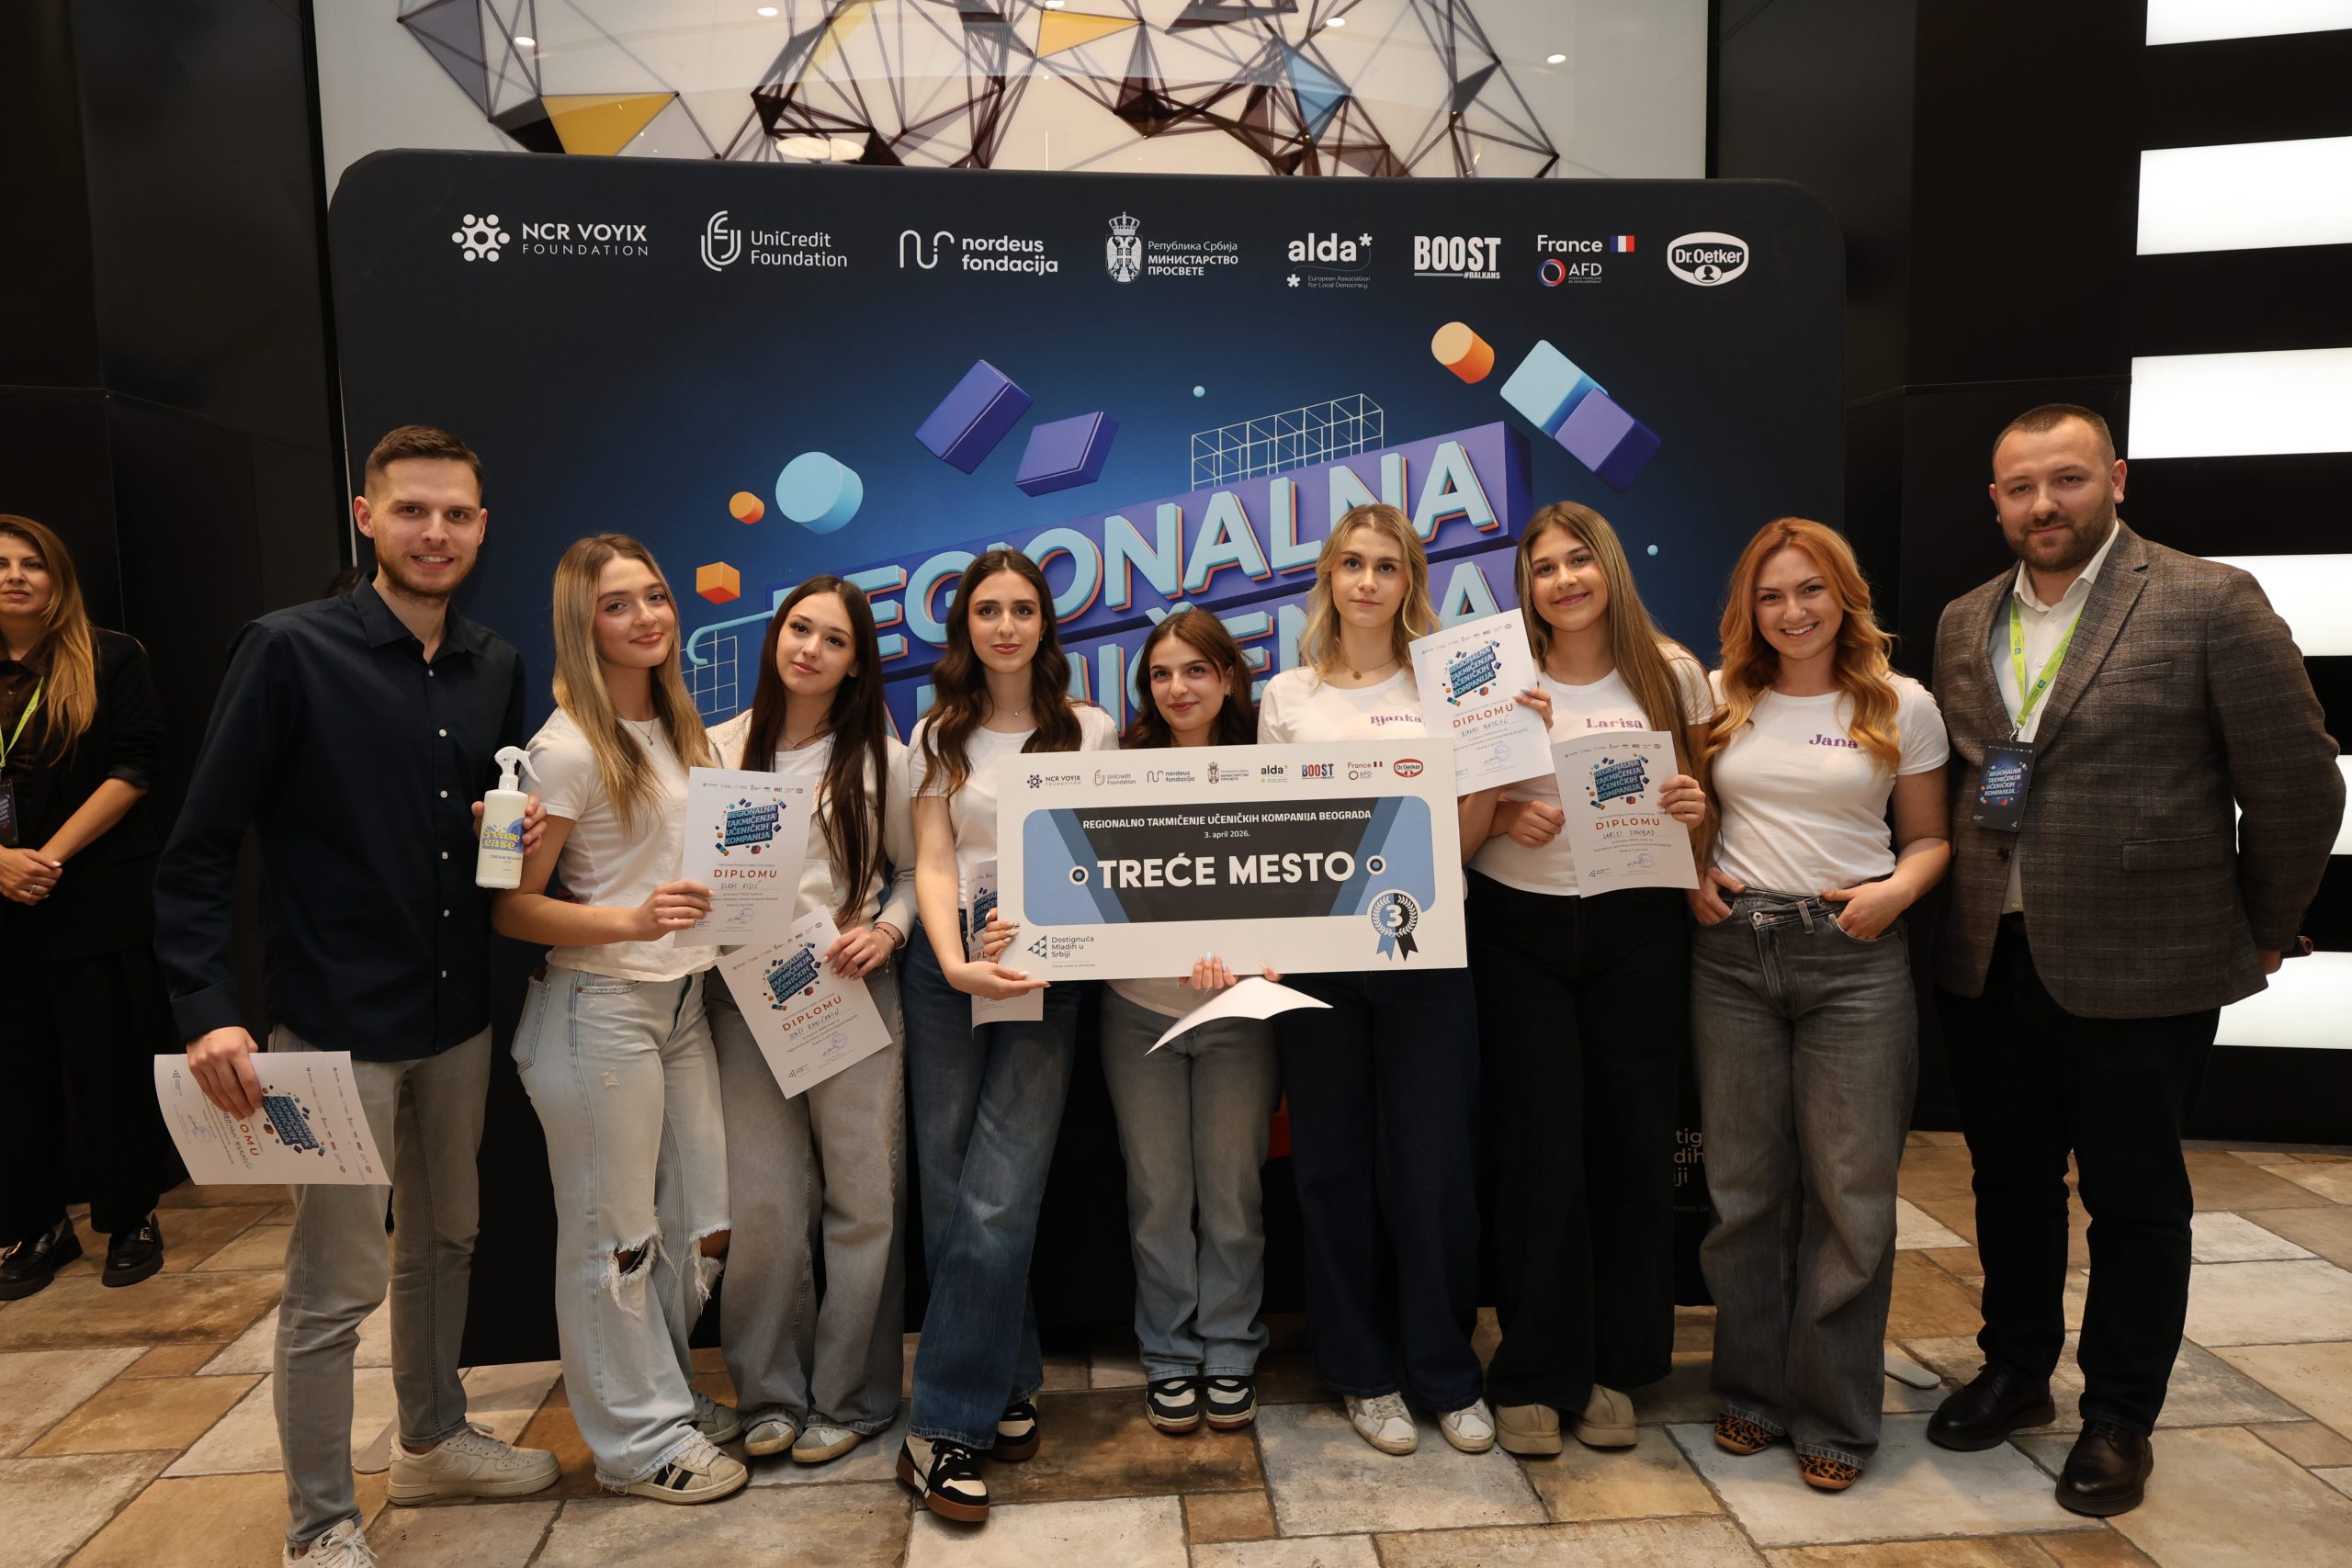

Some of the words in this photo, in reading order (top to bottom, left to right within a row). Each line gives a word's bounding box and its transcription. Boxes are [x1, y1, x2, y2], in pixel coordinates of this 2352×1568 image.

[522, 223, 571, 240] NCR
[577, 223, 647, 242] VOYIX
[751, 230, 831, 248] UniCredit
[522, 243, 649, 257] FOUNDATION
[962, 235, 1044, 253] nordeus
[1148, 241, 1201, 254] Република
[1204, 241, 1238, 254] Србија
[1537, 234, 1603, 253] France
[751, 250, 848, 267] Foundation
[1148, 254, 1238, 265] МИНИСТАРСТВО
[1414, 235, 1501, 272] BOOST
[962, 255, 1058, 276] fondacija
[1148, 265, 1204, 276] ПРОСВЕТЕ
[1568, 263, 1602, 276] AFD
[1307, 275, 1336, 283] European
[1464, 271, 1501, 279] #BALKANS
[1370, 714, 1422, 726] Bjanka
[1453, 703, 1514, 728] DIPLOMU
[1586, 718, 1644, 728] Larisa
[1808, 734, 1858, 749] Jana
[1261, 764, 1284, 775] alda
[1302, 763, 1334, 778] BOOST
[729, 805, 775, 818] REGIONALNA
[727, 814, 776, 828] TAKMIČENJA
[1082, 818, 1146, 829] REGIONALNO
[1147, 814, 1205, 827] TAKMIČENJE
[1207, 812, 1260, 825] UČENIČKIH
[1261, 811, 1318, 824] KOMPANIJA
[1319, 809, 1372, 822] BEOGRADA
[1596, 818, 1660, 830] DIPLOMU
[726, 823, 769, 836] UČENIČKIH
[1204, 830, 1212, 839] 3.
[1213, 829, 1228, 840] april
[1230, 829, 1250, 838] 2026.
[484, 838, 515, 850] ease
[726, 831, 770, 844] KOMPANIJA
[714, 869, 777, 878] DIPLOMU
[1097, 852, 1216, 889] TREĆE
[1228, 851, 1355, 885] MESTO
[1385, 904, 1404, 928] 3
[1051, 935, 1094, 944] Dostignuća
[1051, 942, 1078, 951] Mladih
[1051, 950, 1071, 959] Srbiji
[782, 995, 842, 1032] DIPLOMU
